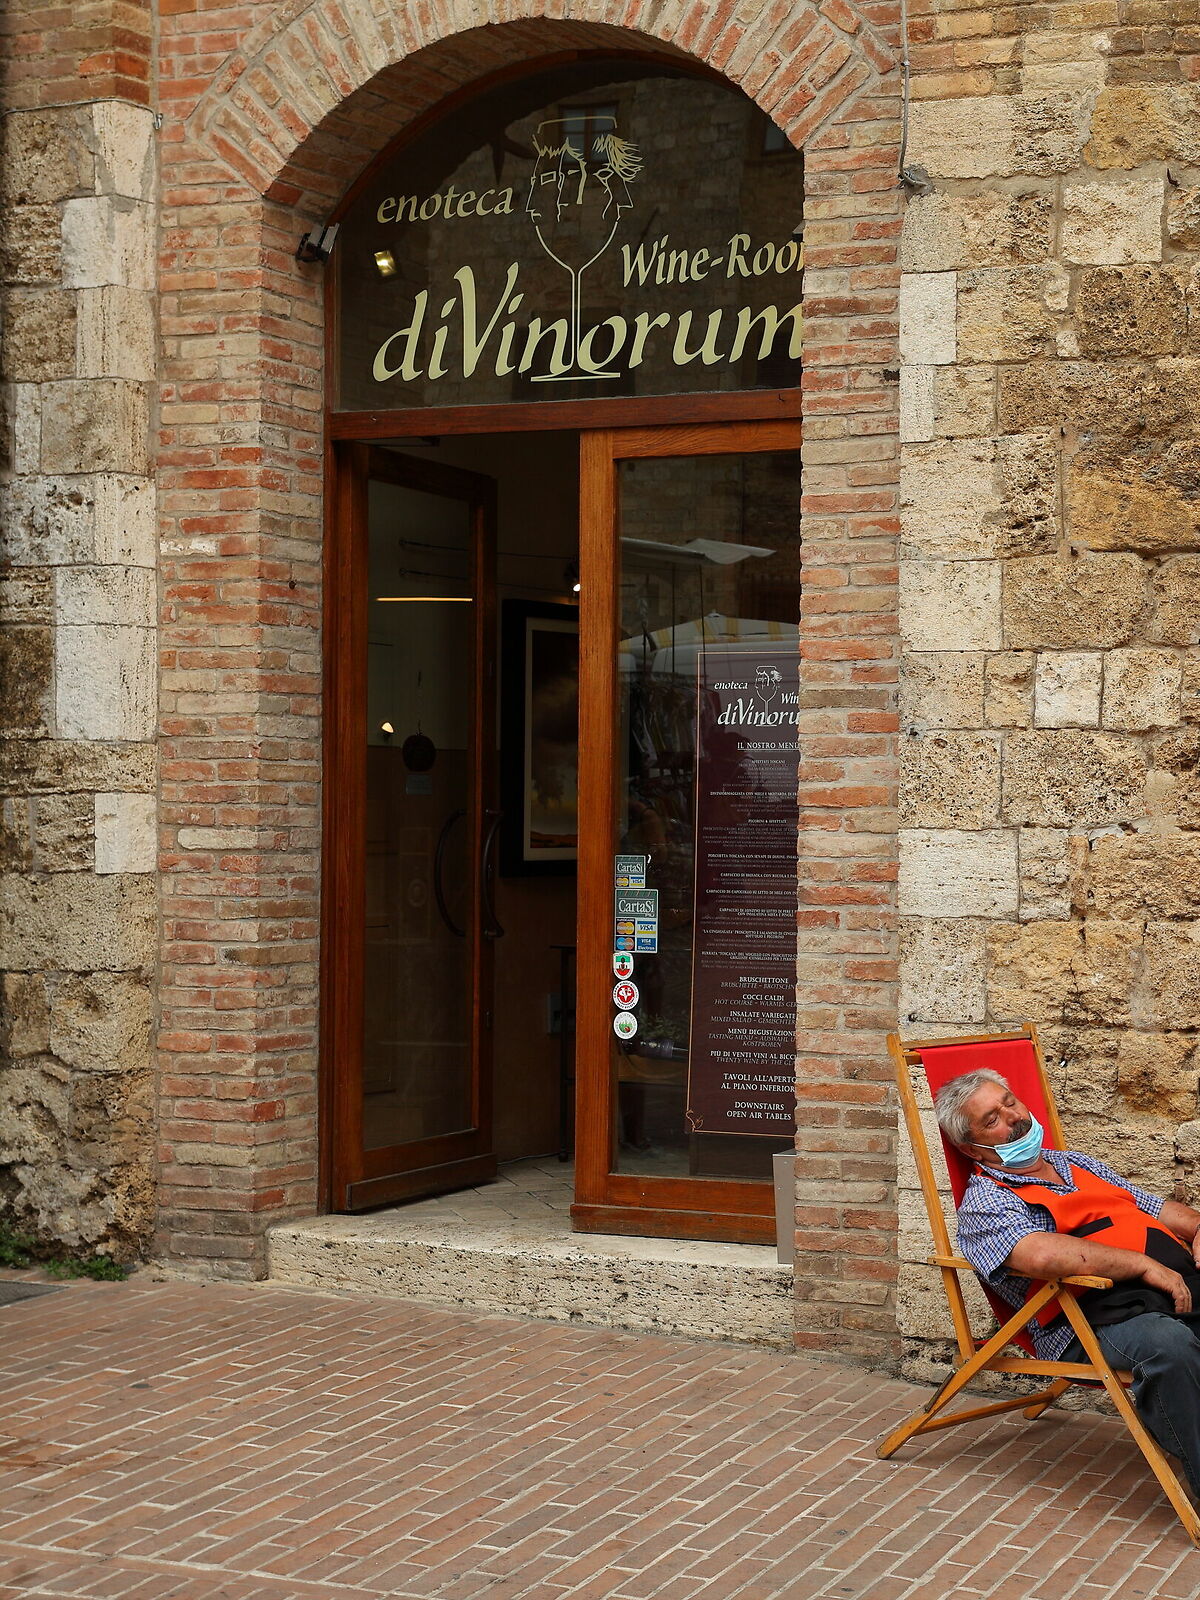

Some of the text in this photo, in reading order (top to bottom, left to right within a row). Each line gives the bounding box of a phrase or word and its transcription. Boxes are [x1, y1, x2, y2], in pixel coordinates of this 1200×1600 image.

[376, 185, 515, 224] enoteca
[372, 261, 802, 382] diVinorum
[714, 680, 748, 690] enoteca
[739, 976, 789, 984] BRUSCHETTONE
[730, 1010, 760, 1018] INSALATE
[723, 1072, 797, 1083] TAVOLI ALL'APERTO
[734, 1101, 785, 1110] DOWNSTAIRS
[726, 1110, 792, 1120] OPEN AIR TABLES
